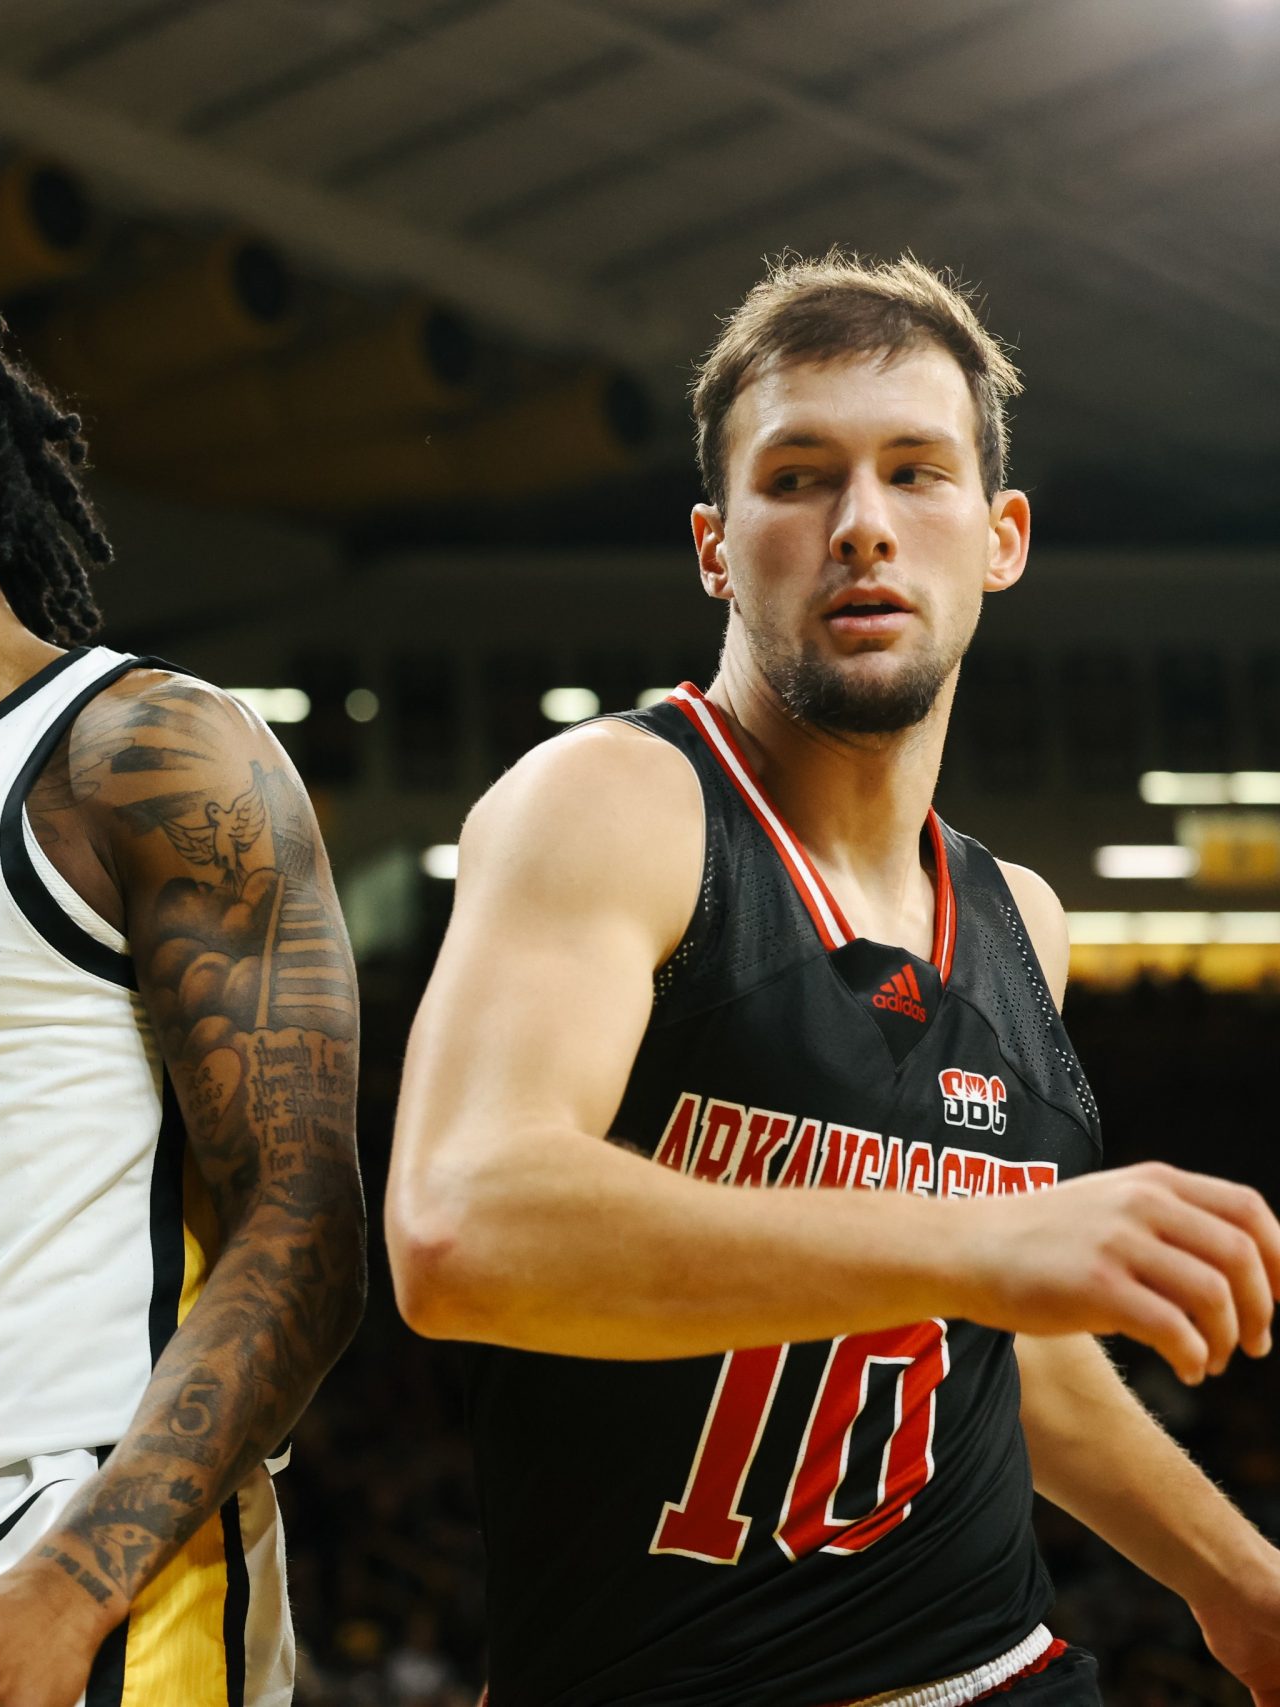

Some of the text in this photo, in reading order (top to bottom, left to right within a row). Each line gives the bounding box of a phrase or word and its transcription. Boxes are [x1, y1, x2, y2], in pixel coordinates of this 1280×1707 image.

[872, 993, 927, 1023] adidas
[938, 1068, 1007, 1135] SBC
[649, 1317, 950, 1566] 10
